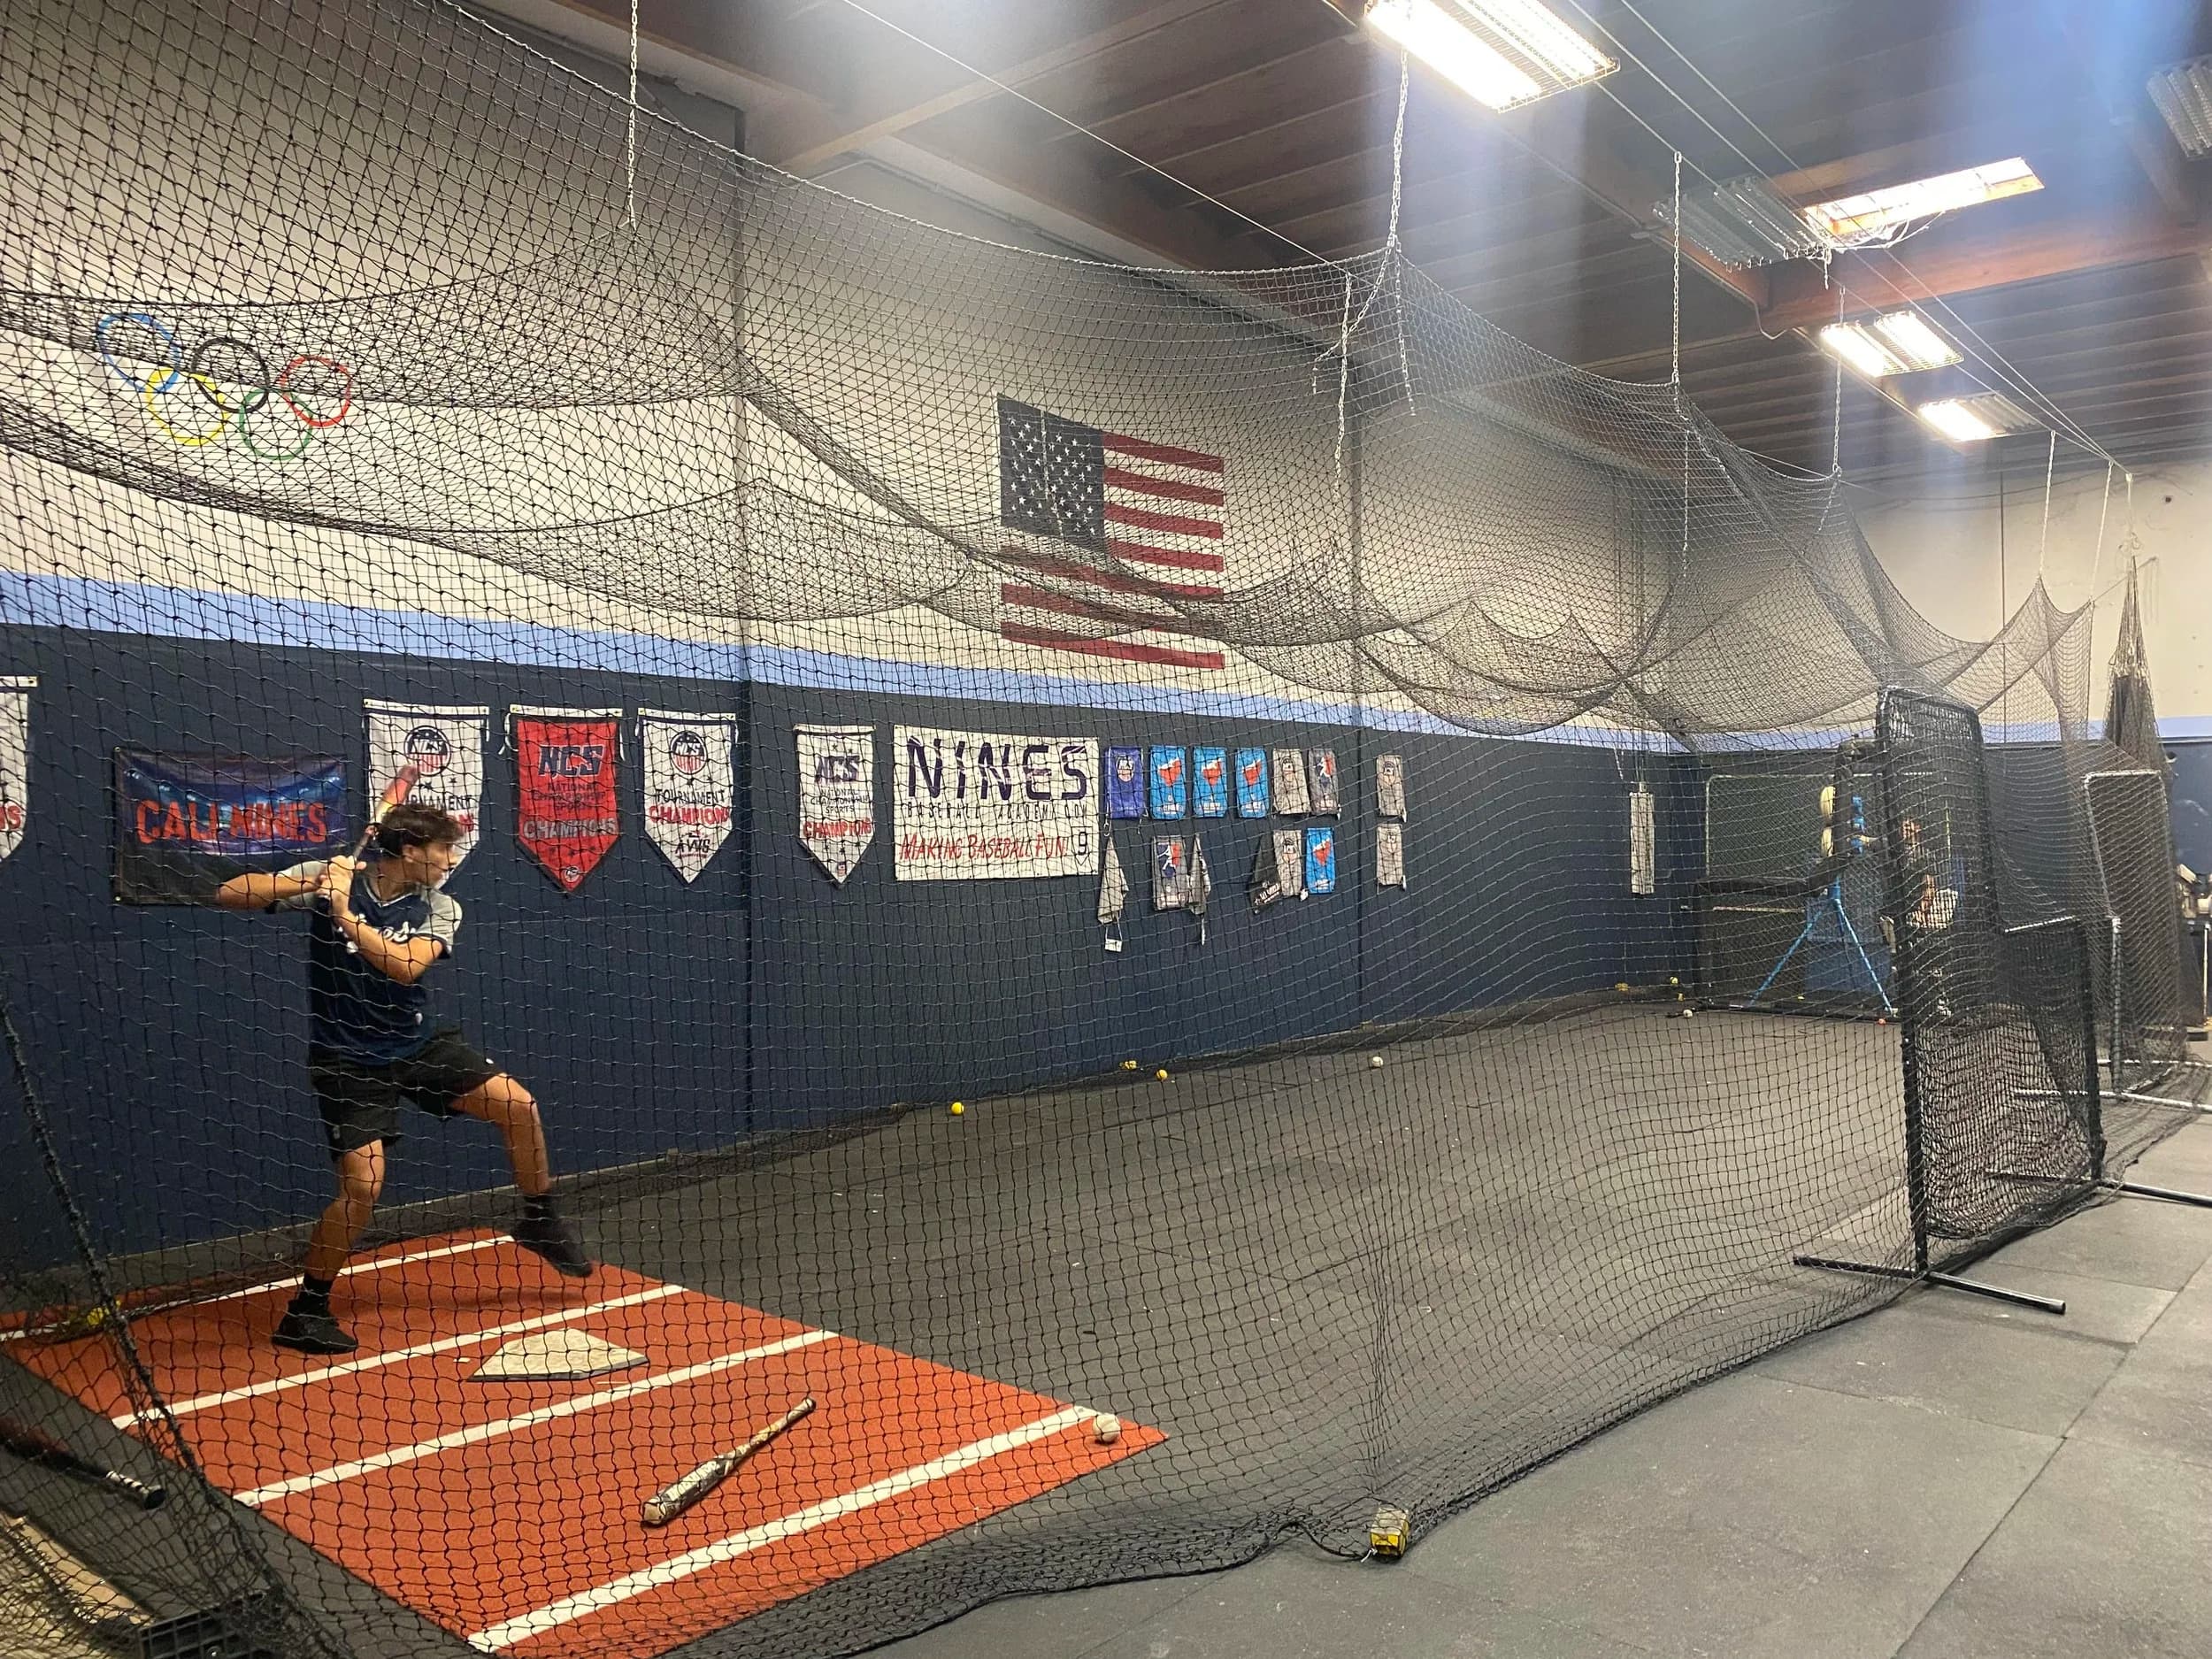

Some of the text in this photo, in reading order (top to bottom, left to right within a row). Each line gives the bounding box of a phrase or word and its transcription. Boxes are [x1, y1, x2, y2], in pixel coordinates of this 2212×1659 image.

[538, 745, 604, 779] NCS
[815, 756, 860, 784] NCS
[906, 735, 1087, 801] NINES
[655, 788, 726, 804] TOURNAMENT
[649, 805, 730, 825] CHAMPIONS
[825, 805, 855, 814] SPORTS
[907, 803, 980, 819] BASEBALL
[136, 799, 326, 844] CALI NINES
[523, 818, 618, 839] CHAMPIONS
[803, 818, 872, 838] CHAMPIONS
